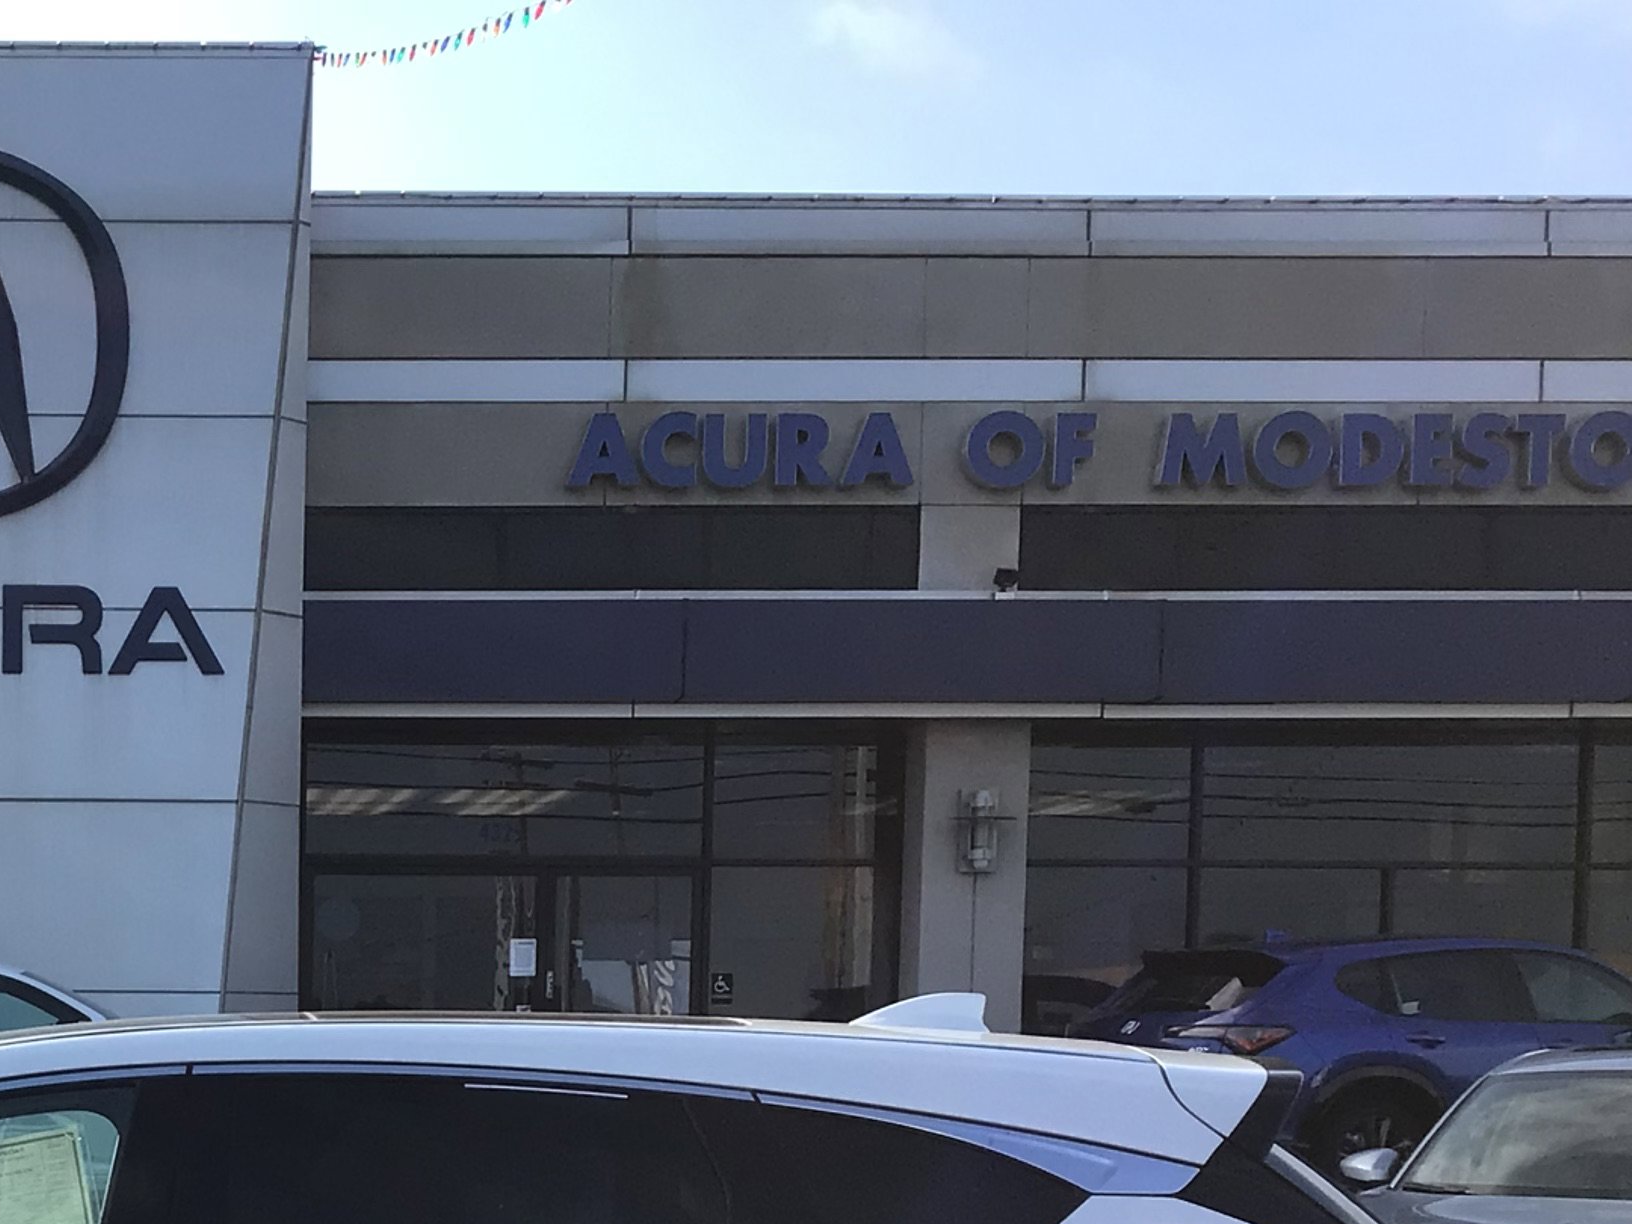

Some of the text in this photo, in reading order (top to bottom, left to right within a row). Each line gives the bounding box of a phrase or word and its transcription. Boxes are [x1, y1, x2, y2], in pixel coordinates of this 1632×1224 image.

[568, 409, 1632, 489] ACURA OF MODESTO
